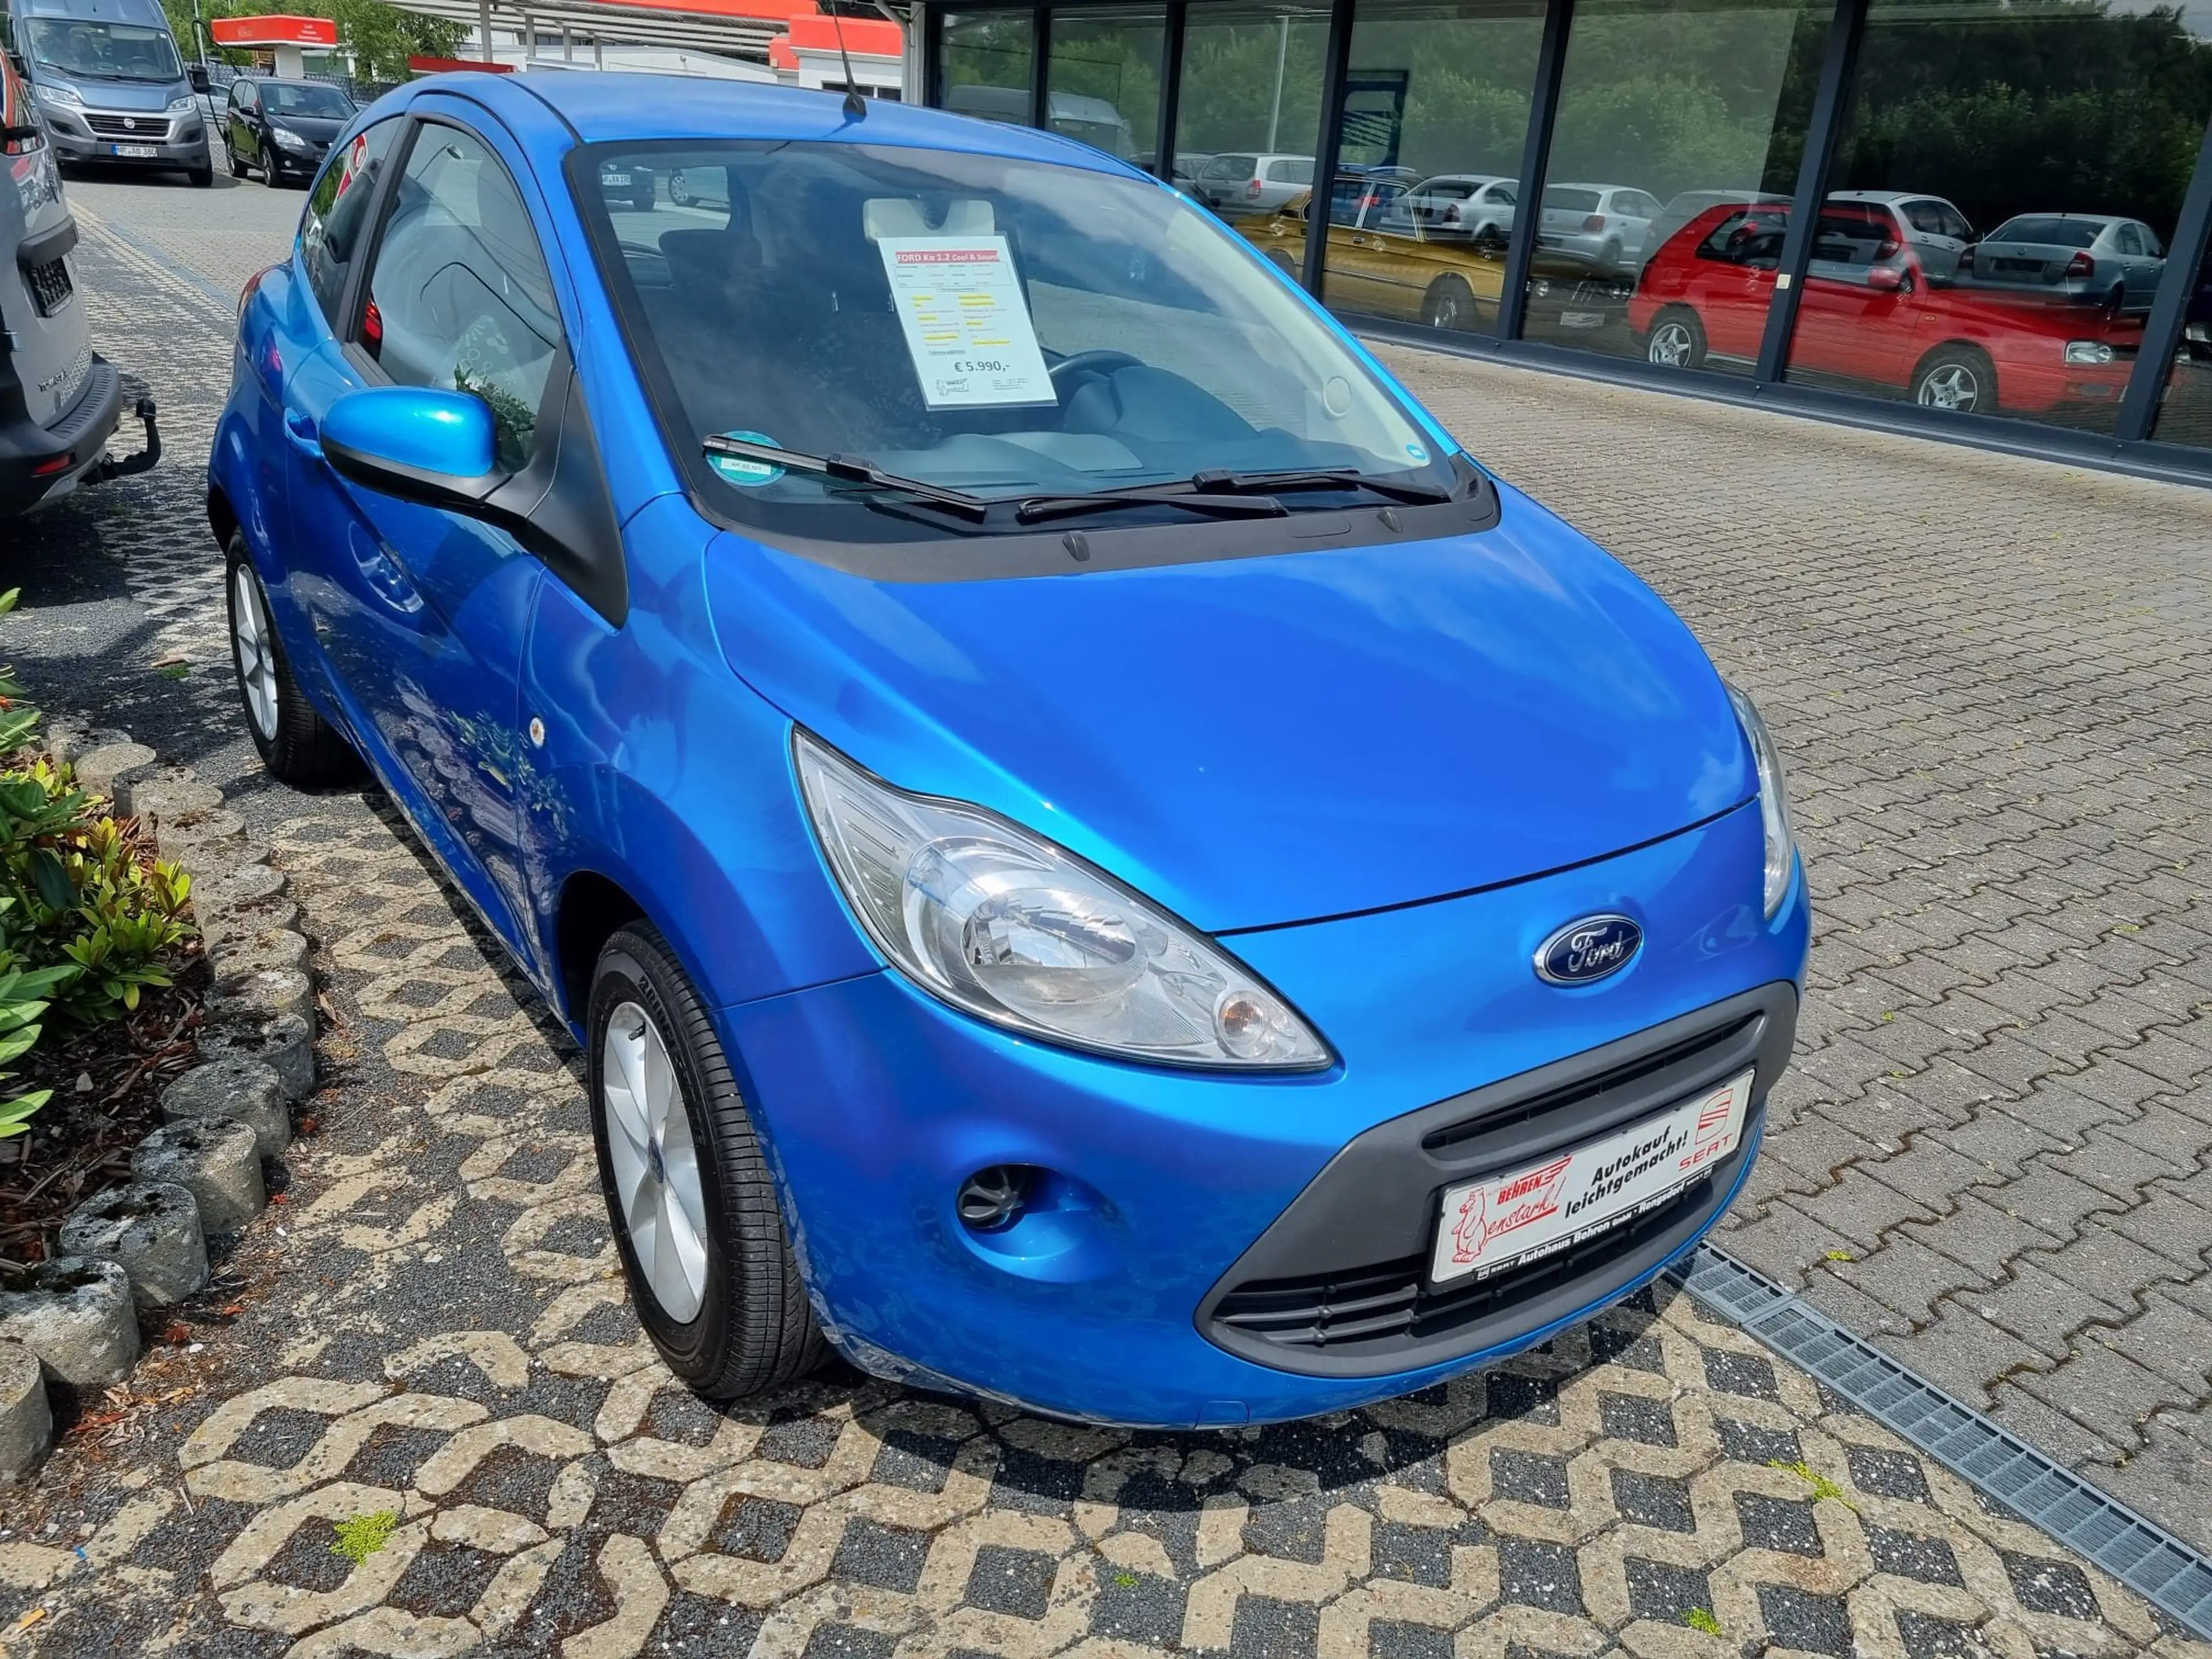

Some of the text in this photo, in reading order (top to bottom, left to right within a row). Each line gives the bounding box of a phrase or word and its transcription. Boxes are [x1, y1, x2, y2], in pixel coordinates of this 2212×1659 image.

[955, 361, 1010, 372] € 5.990,-
[1568, 926, 1626, 972] Ford
[1565, 1130, 1688, 1219] leichtgemacht!
[1590, 1124, 1671, 1187] Autokauf
[1679, 1132, 1732, 1172] SEAT
[1497, 1175, 1543, 1206] BEHREN
[1517, 1236, 1571, 1266] Autohaus
[1573, 1221, 1610, 1244] Behren
[1638, 1181, 1686, 1214] Rengsdorf
